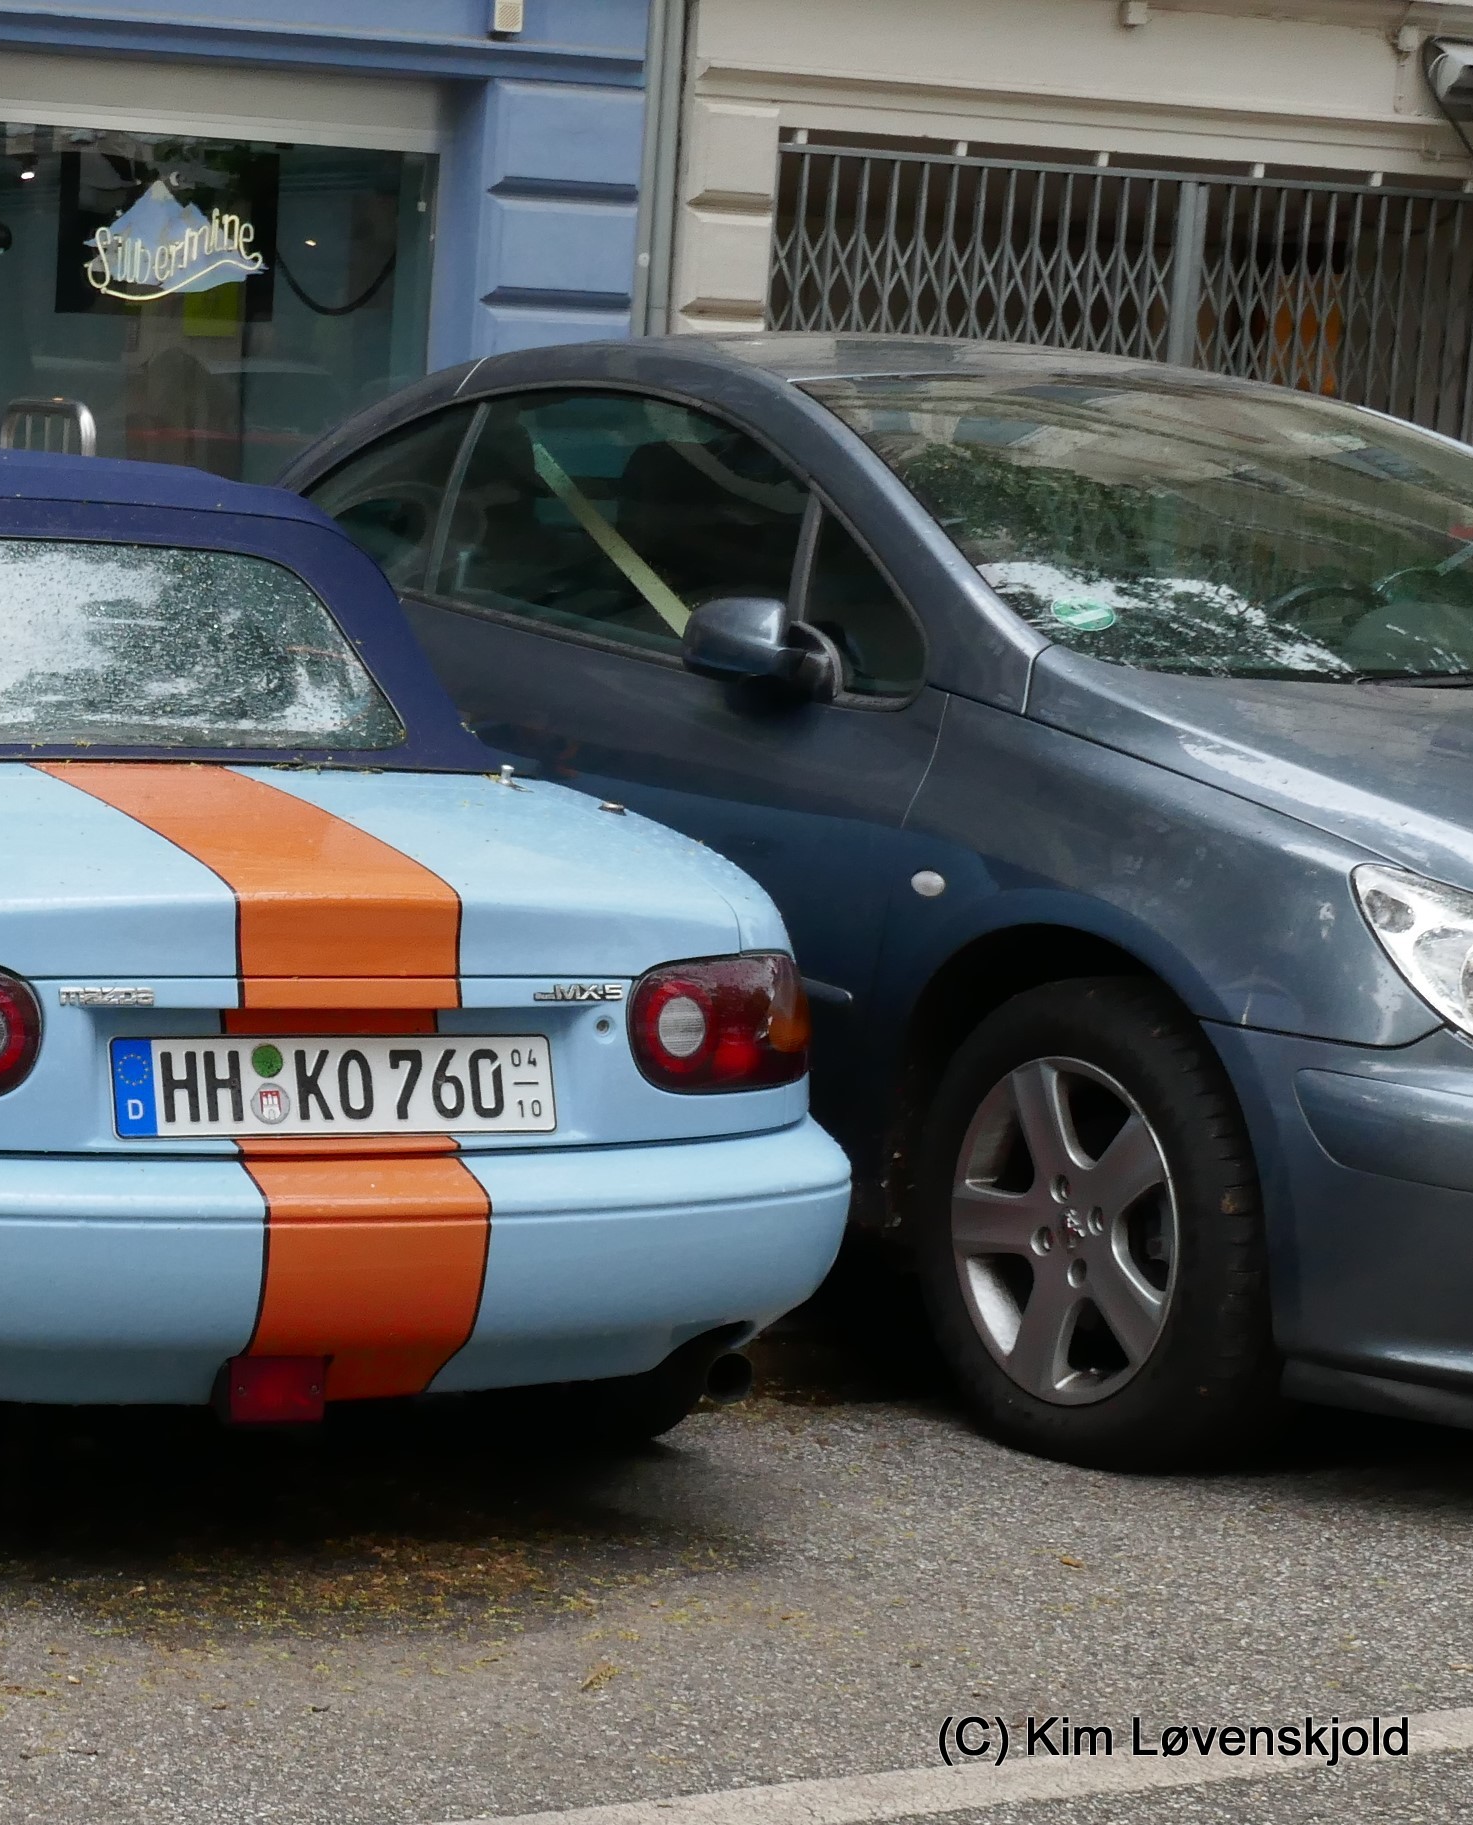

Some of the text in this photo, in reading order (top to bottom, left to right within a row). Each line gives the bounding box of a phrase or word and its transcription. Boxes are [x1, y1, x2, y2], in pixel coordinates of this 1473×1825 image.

[85, 208, 263, 290] Silbermine
[554, 984, 623, 1001] MX-5
[510, 1048, 538, 1068] 04
[159, 1048, 505, 1123] HH KO 760
[127, 1099, 144, 1120] D
[517, 1099, 542, 1118] 10
